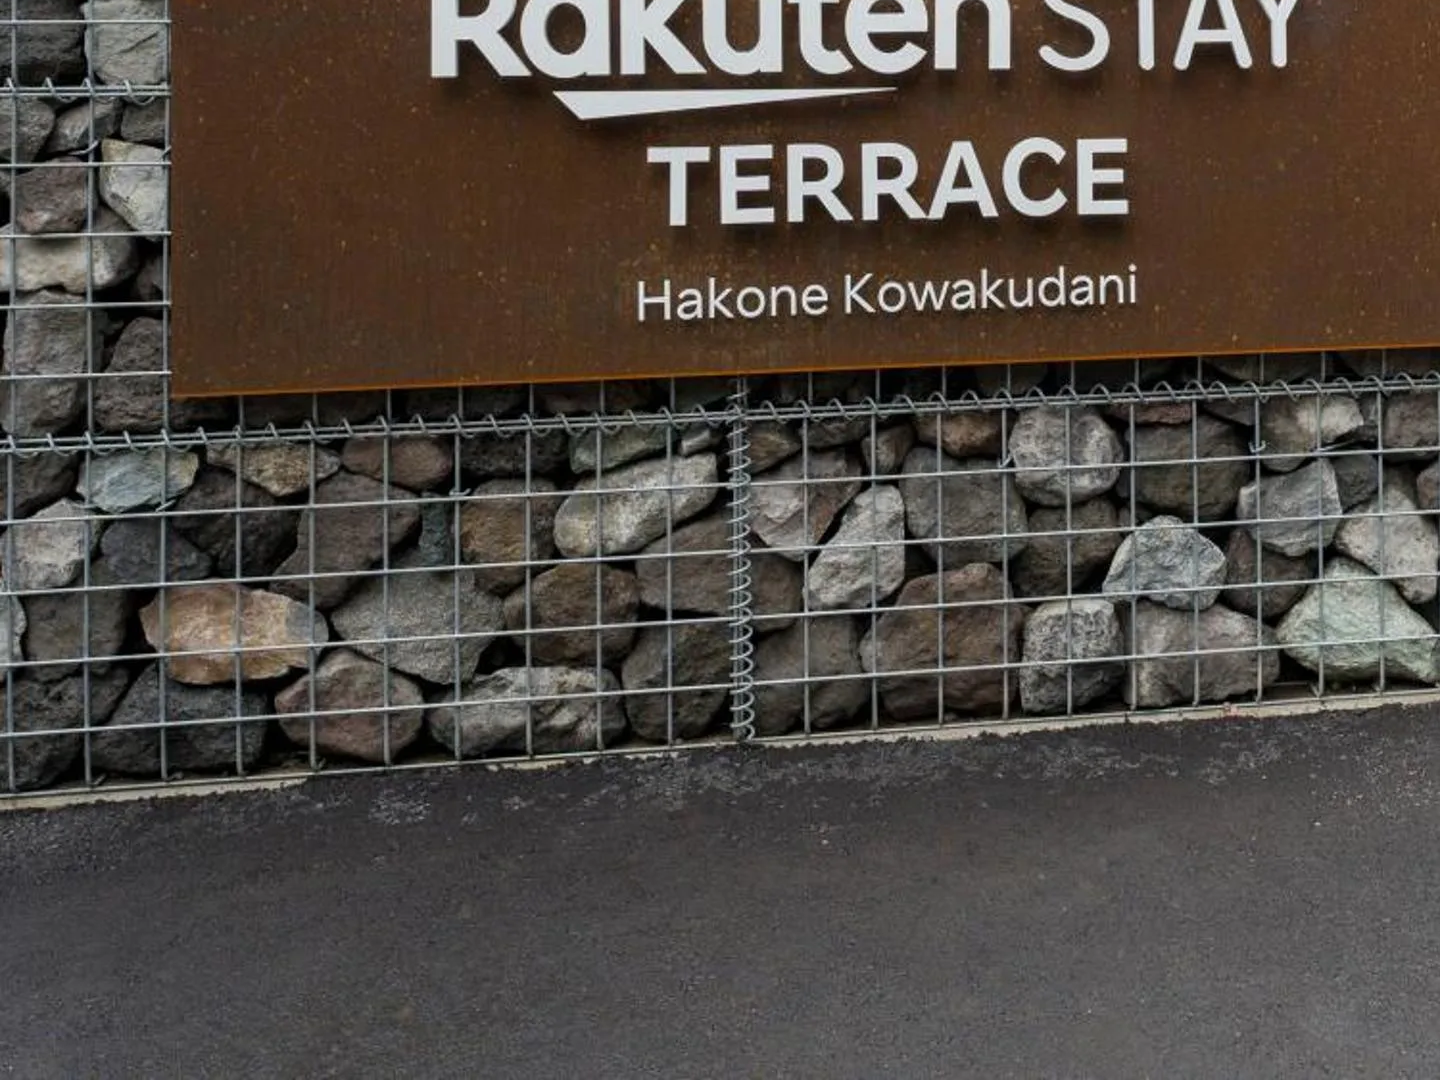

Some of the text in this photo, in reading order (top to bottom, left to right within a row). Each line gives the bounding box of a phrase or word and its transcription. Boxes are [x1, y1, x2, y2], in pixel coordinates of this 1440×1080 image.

[645, 136, 1130, 226] TERRACE
[636, 263, 1138, 322] Hakone Kowakudani
